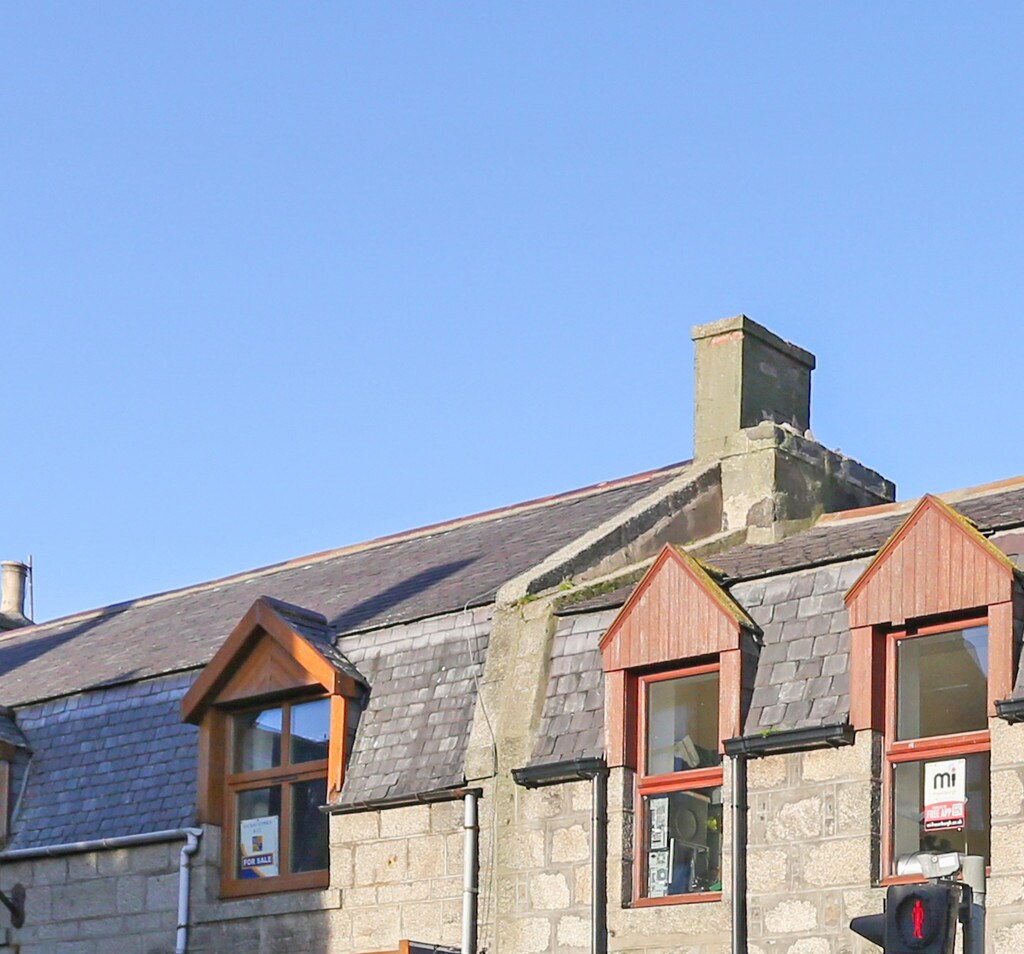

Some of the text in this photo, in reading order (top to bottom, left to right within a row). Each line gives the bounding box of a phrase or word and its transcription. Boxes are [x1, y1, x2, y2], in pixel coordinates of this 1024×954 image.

[933, 767, 956, 790] mi
[243, 855, 272, 867] FOR SALE
